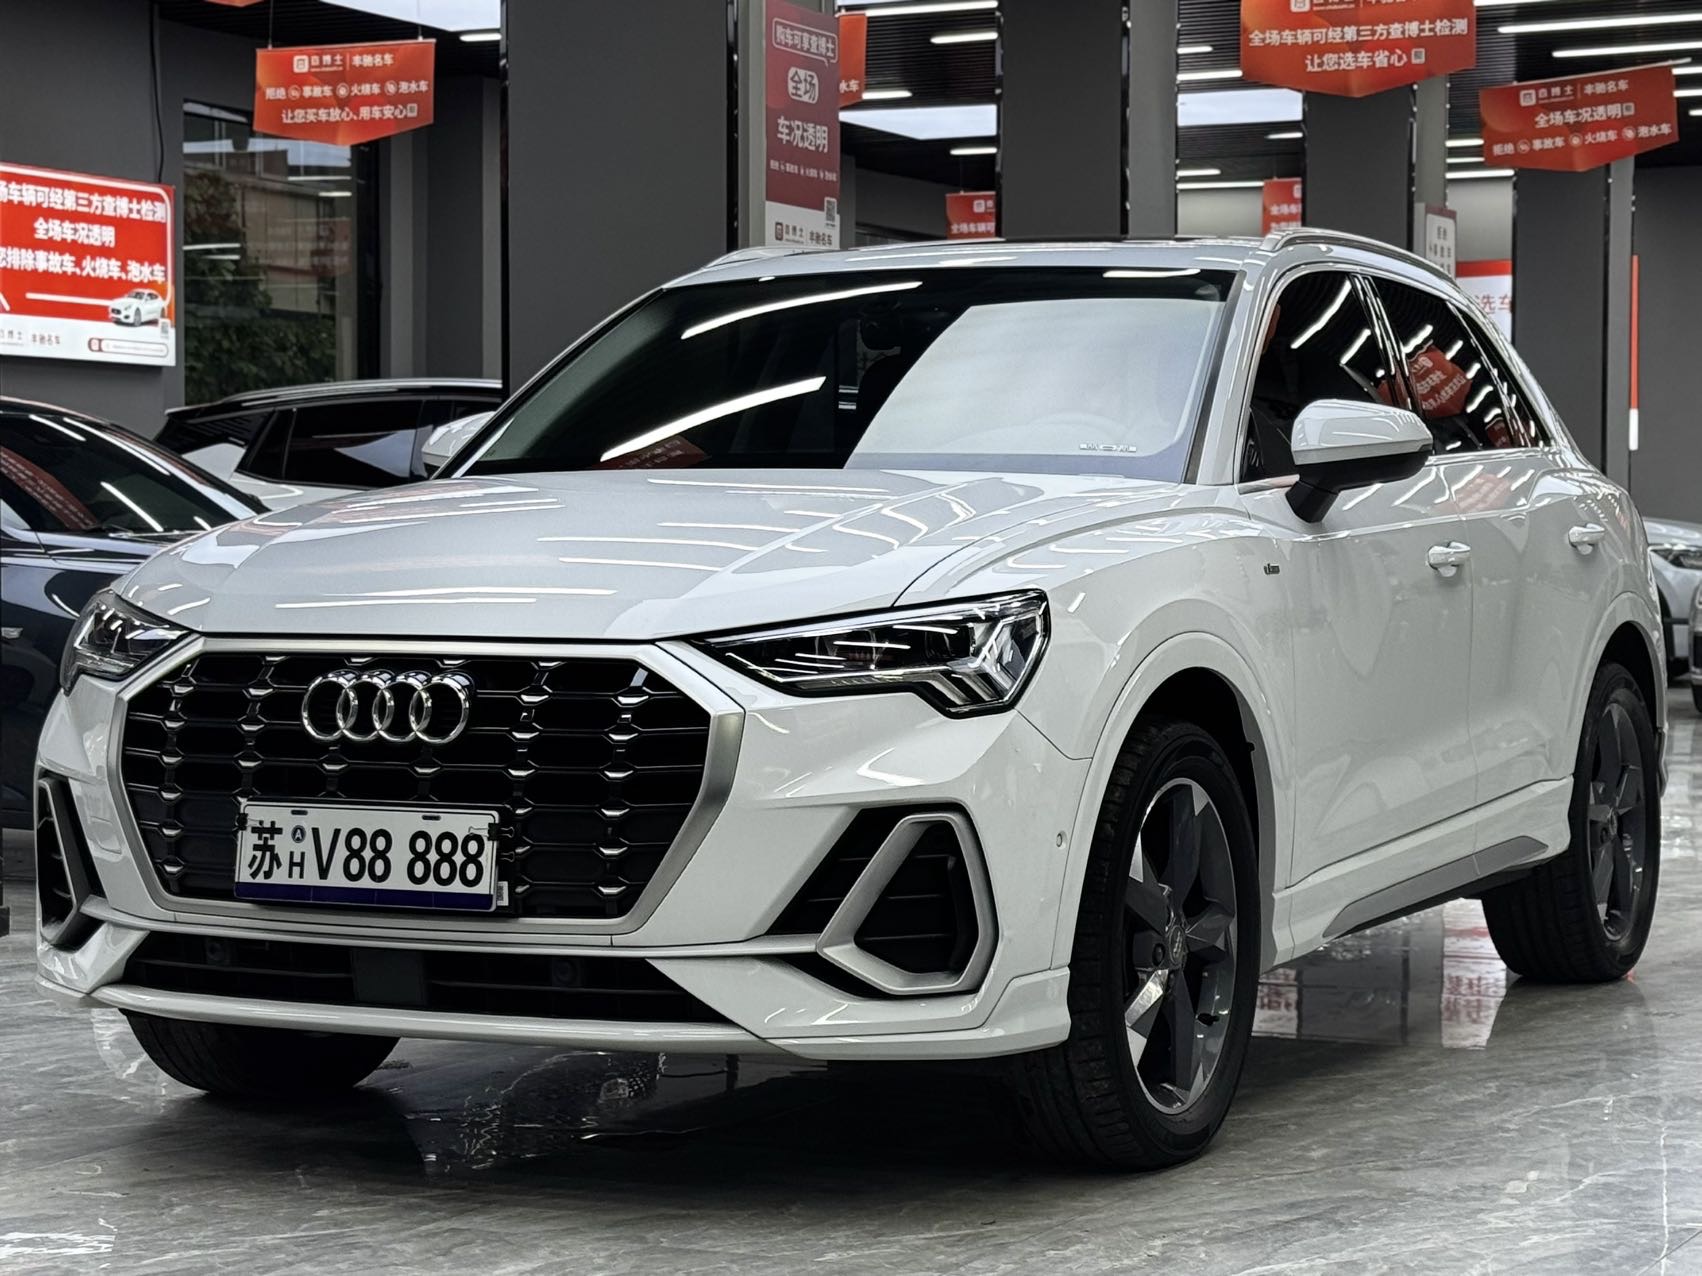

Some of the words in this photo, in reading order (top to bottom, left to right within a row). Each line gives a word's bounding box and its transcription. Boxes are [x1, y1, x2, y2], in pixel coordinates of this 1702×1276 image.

[1249, 18, 1468, 47] 全场车辆可经第三方查博士检测
[1305, 49, 1407, 72] 让您选车省心
[790, 70, 816, 101] 全场
[281, 106, 406, 124] 让您买车放心、用车安心
[1534, 103, 1621, 129] 全场车况透明
[777, 115, 829, 153] 车况透明
[34, 216, 116, 248] 全场车况透明
[248, 820, 283, 881] 苏
[288, 851, 306, 880] H
[311, 827, 393, 884] V88
[406, 830, 485, 888] 888
